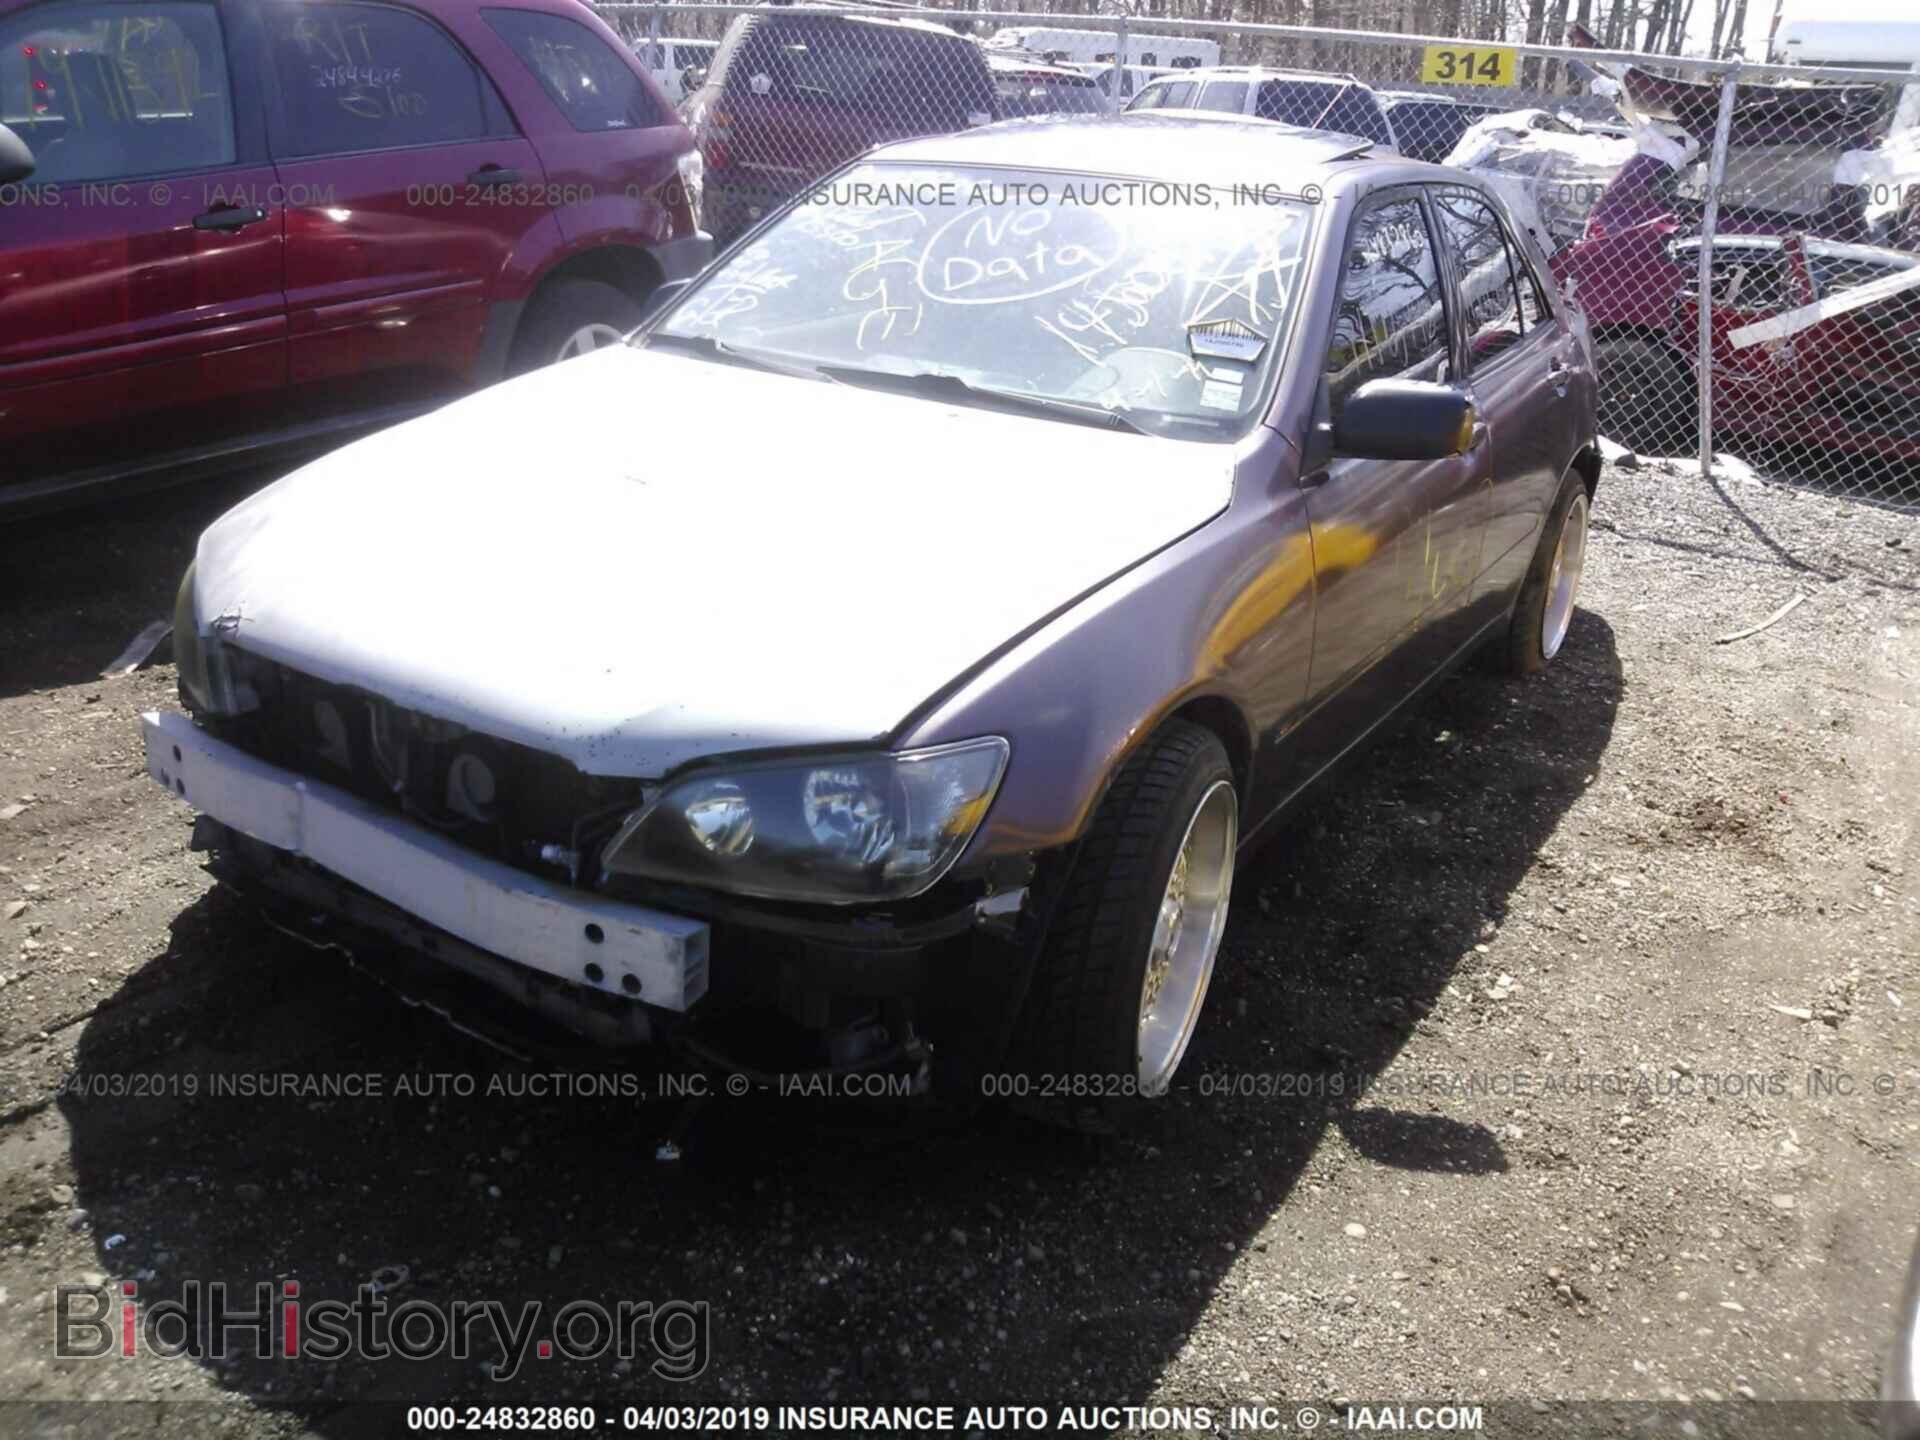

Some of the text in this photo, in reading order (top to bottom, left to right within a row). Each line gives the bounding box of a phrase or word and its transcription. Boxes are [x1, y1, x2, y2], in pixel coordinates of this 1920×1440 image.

[1435, 51, 1501, 80] 314
[964, 208, 1052, 248] NO
[944, 240, 1106, 292] Data
